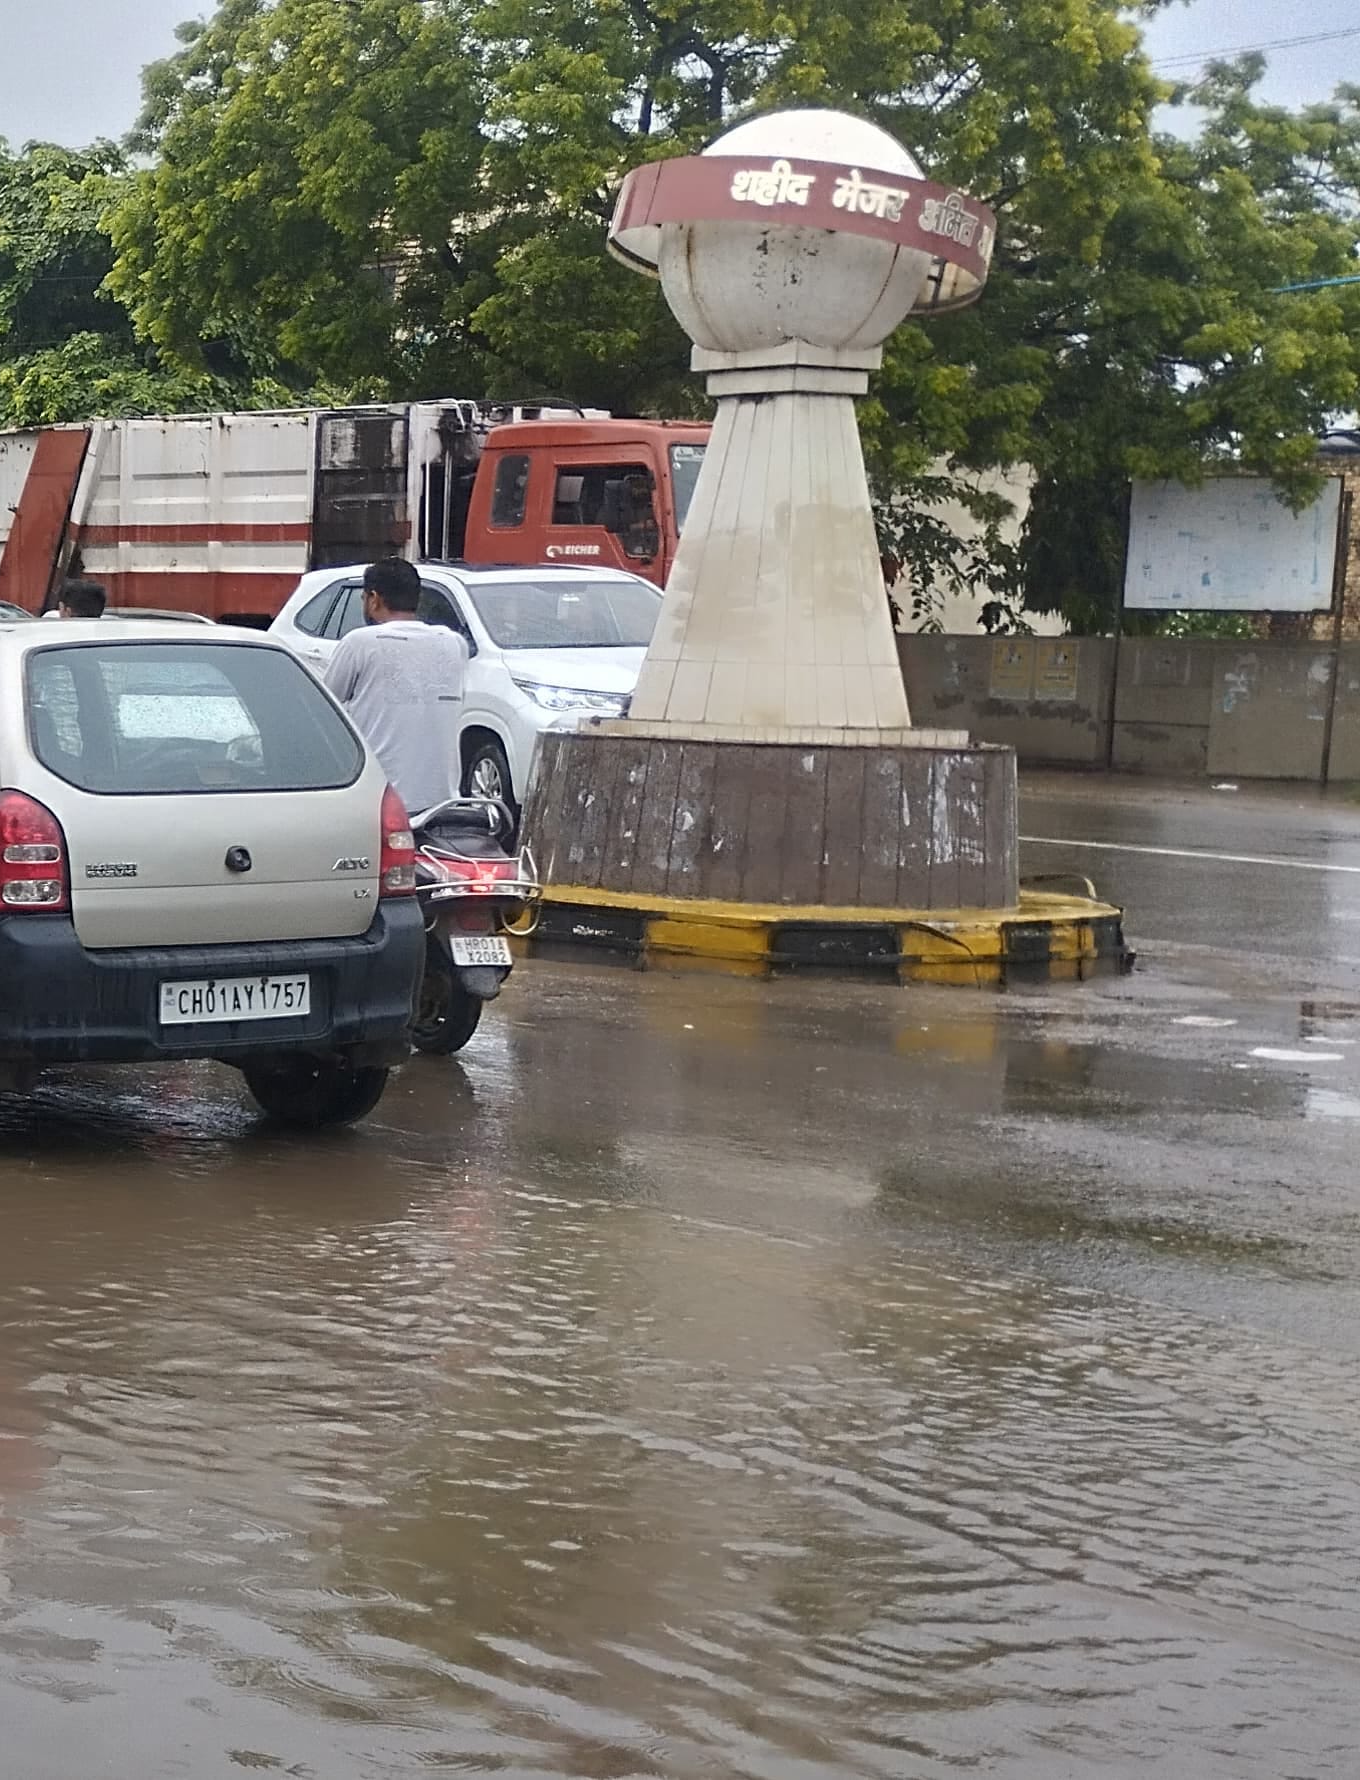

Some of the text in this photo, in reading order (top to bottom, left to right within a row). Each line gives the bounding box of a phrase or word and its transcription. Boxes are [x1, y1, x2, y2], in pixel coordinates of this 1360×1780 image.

[731, 159, 816, 206] शहीद
[832, 169, 909, 223] मेजर
[564, 544, 600, 555] EICHER
[331, 857, 369, 871] ALTO
[178, 981, 307, 1015] CH01AY1757
